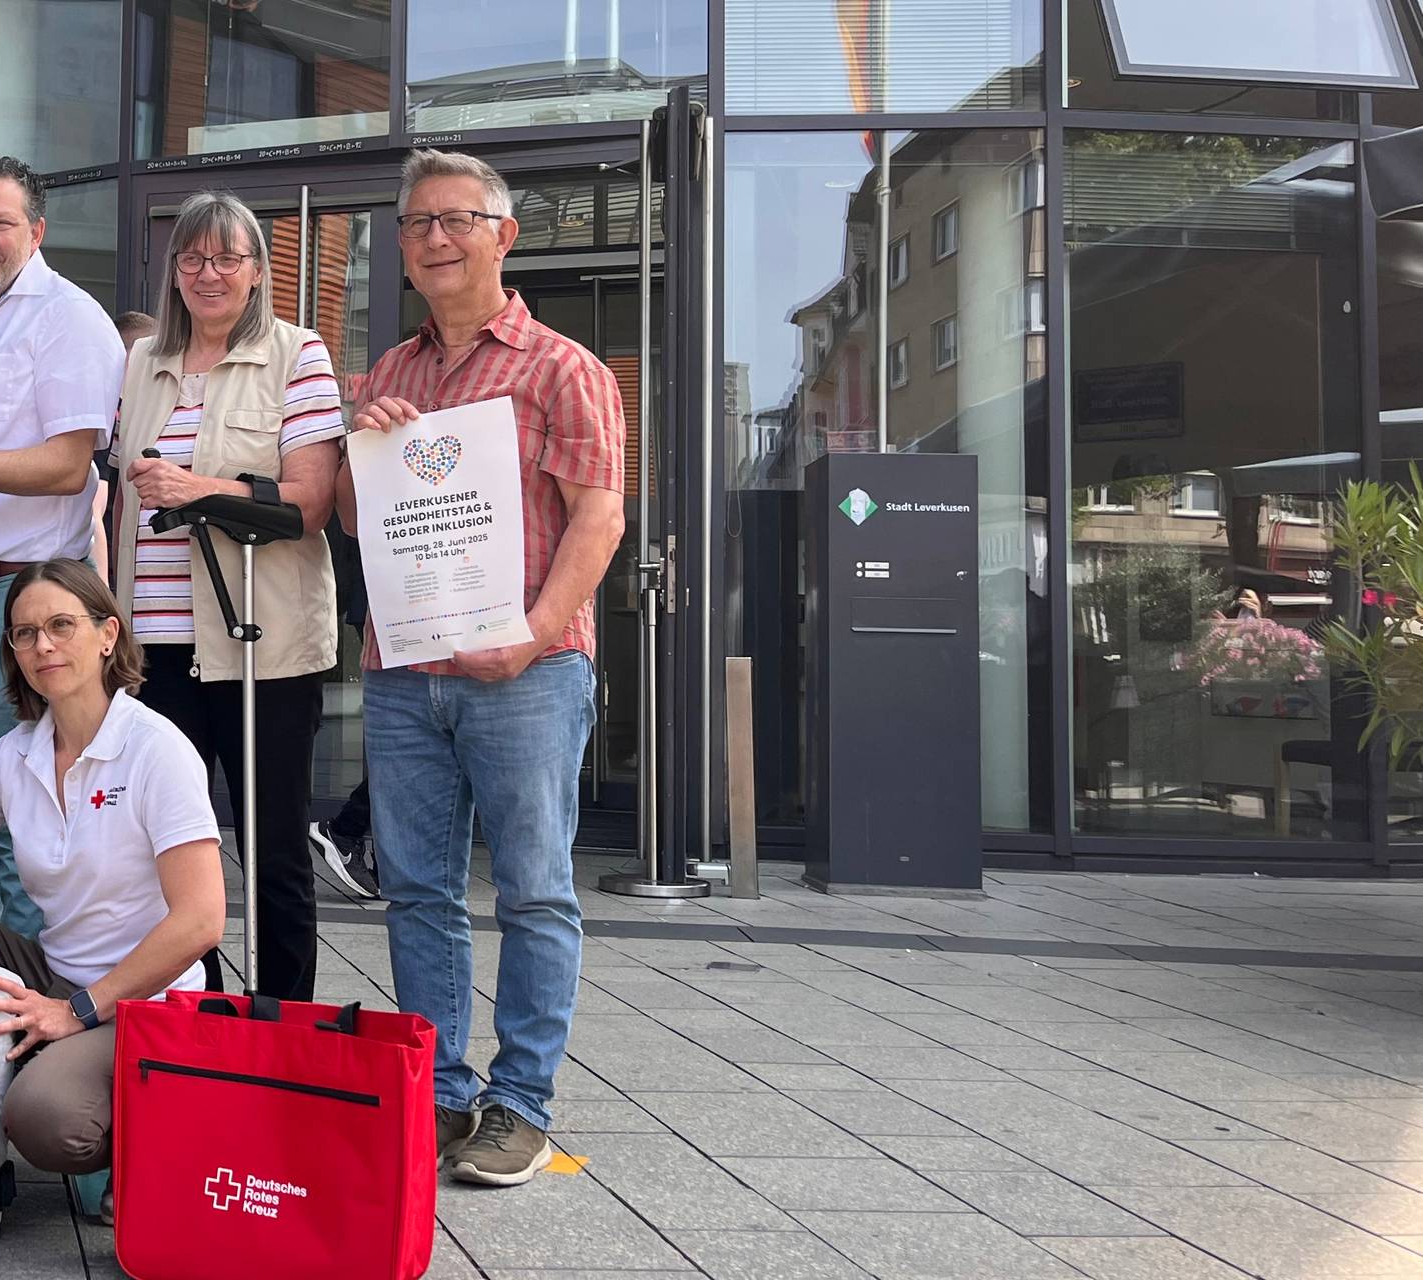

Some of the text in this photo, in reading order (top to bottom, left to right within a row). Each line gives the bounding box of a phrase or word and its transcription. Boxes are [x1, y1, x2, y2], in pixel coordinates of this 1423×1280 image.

[394, 490, 478, 512] LEVERKUSENER
[885, 502, 970, 513] Stadt Leverkusen
[383, 502, 492, 527] GESUNDHEITSTAG &
[385, 514, 493, 541] TAG DER INKLUSION
[392, 543, 431, 556] Samstag,
[447, 537, 466, 547] Juni
[467, 533, 489, 544] 2025
[415, 547, 466, 561] 10 bis 14 Uhr
[244, 1187, 280, 1205] Rotes
[246, 1174, 307, 1198] Deutsches
[242, 1199, 278, 1219] Kreuz
